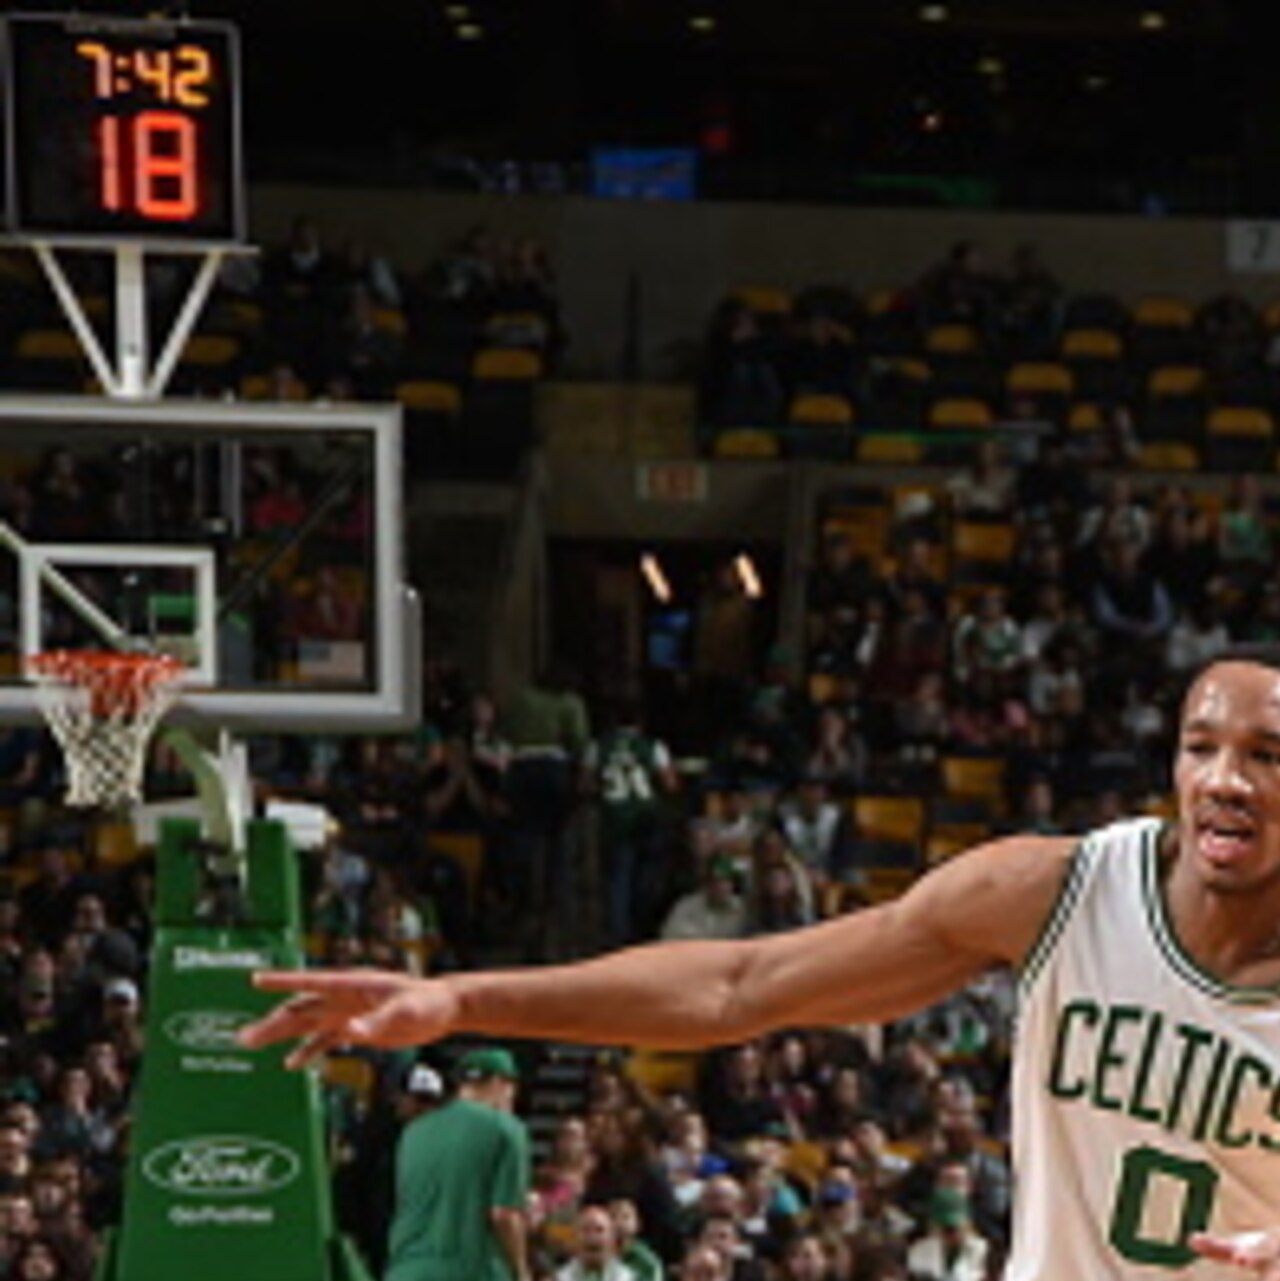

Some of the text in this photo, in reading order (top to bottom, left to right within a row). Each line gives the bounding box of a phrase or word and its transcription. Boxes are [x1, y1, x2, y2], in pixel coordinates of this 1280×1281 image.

[76, 42, 211, 107] 7:42
[102, 111, 196, 219] 18
[170, 1146, 276, 1184] Ford
[1109, 1145, 1221, 1269] 0
